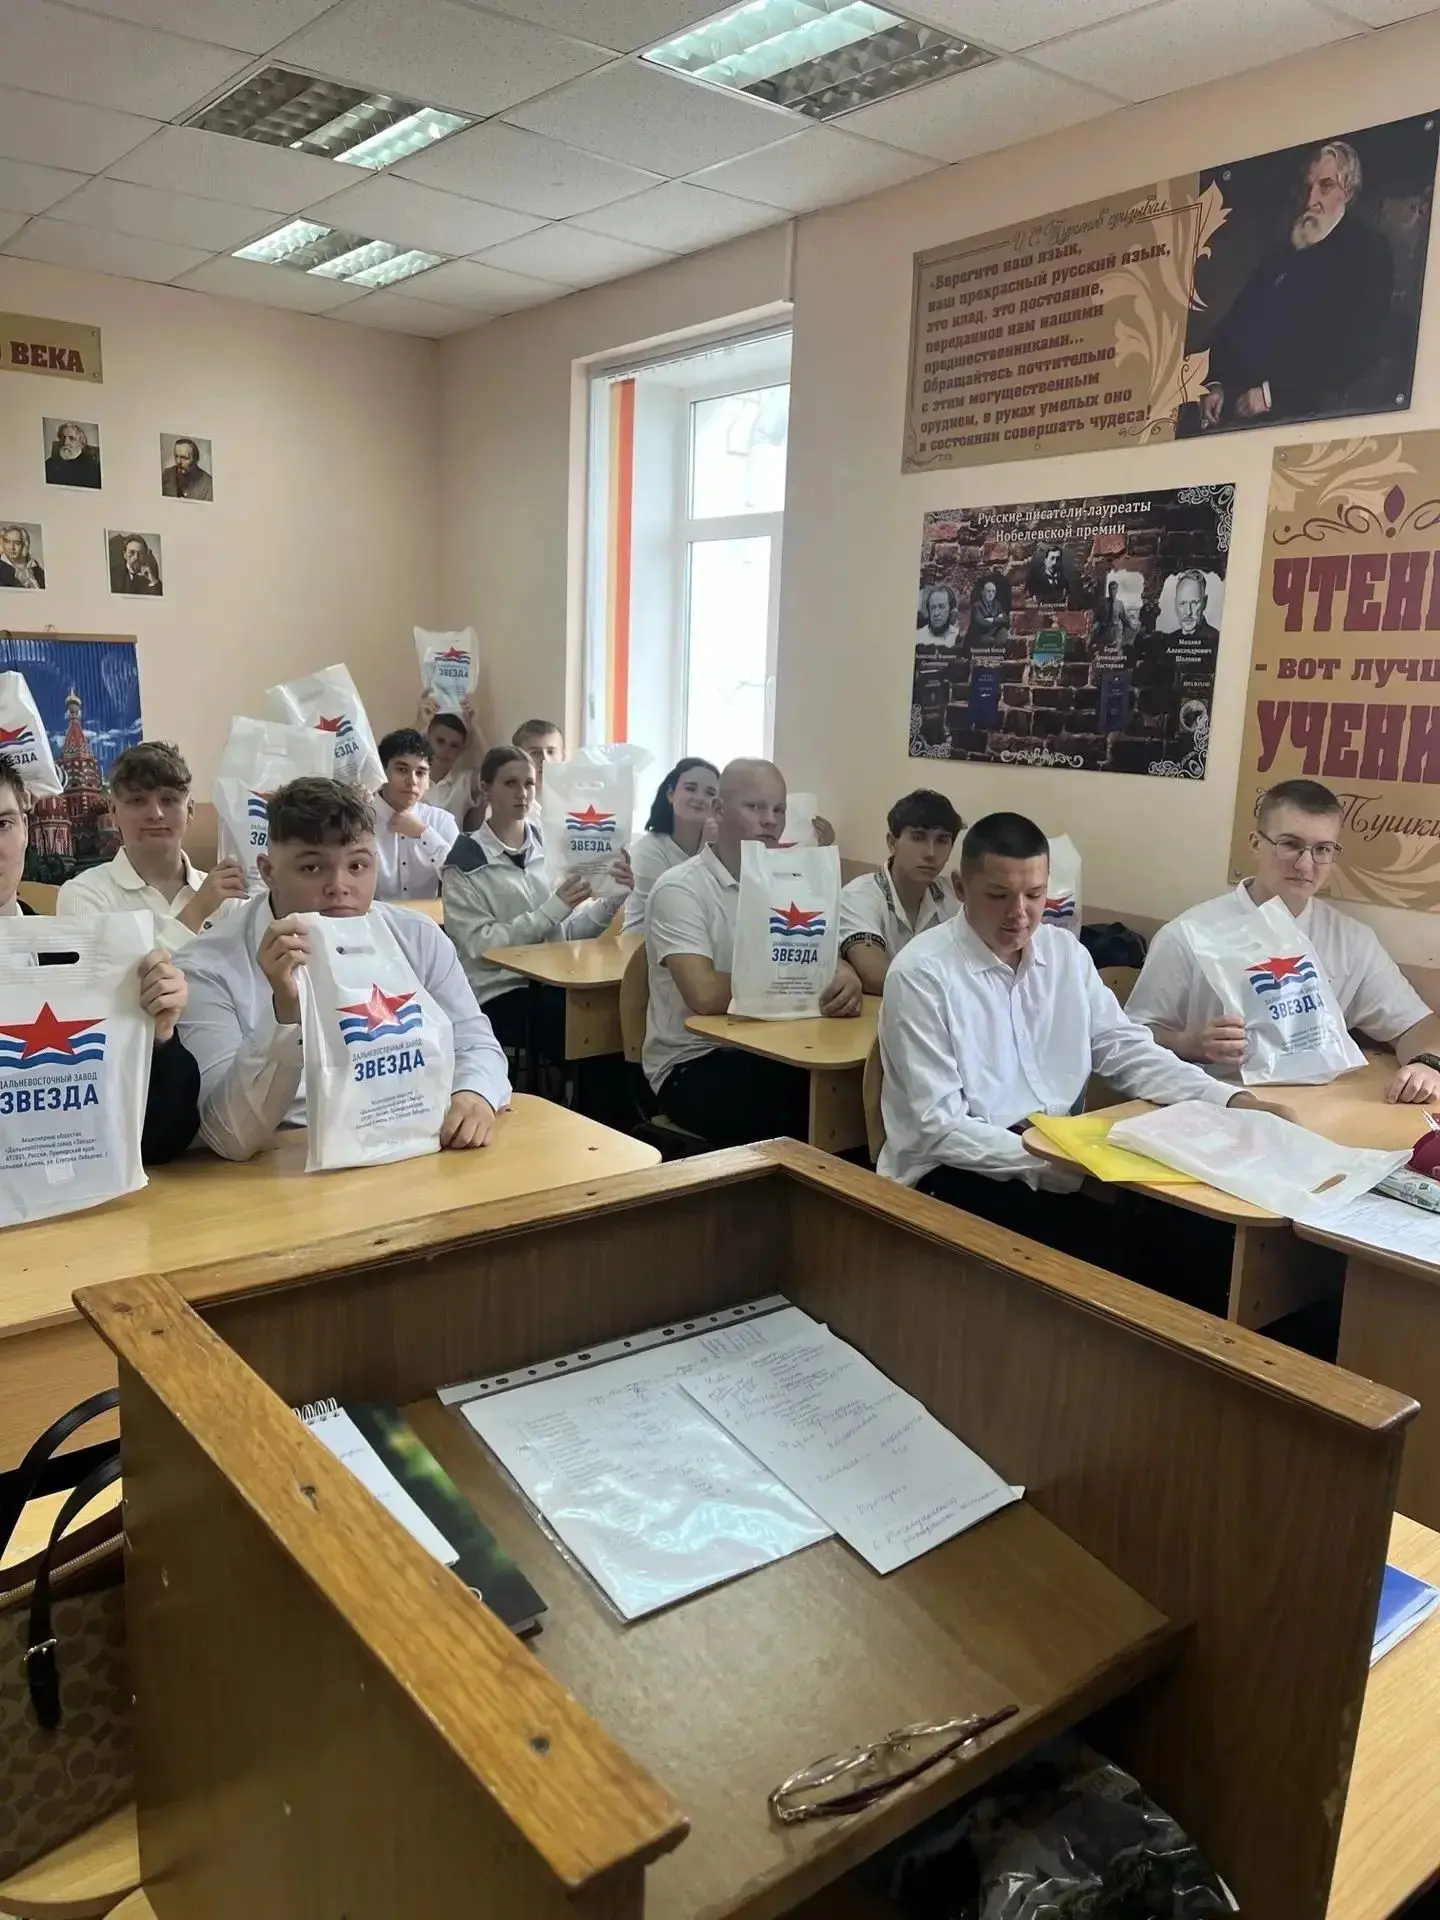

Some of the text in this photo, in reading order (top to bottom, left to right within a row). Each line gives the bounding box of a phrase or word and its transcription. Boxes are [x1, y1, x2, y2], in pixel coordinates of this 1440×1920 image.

[1003, 255, 1033, 273] наш
[1038, 243, 1082, 263] язык,
[928, 243, 1171, 313] наш прекрасный русский язык,
[926, 282, 1104, 334] это клад, это достояние,
[926, 304, 1104, 354] переданное нам нашими
[10, 340, 85, 374] ВЕКА
[923, 347, 1116, 394] Обращайтесь почтительно
[924, 335, 1084, 375] предшественниками...
[921, 372, 1101, 413] с этим могущественным
[920, 388, 1132, 435] орудием, в руках умелых оно
[919, 404, 1152, 453] в состоянии совершать чудеса!
[977, 501, 1152, 528] Русские писатели-лауреаты
[996, 523, 1126, 543] Нобелевской премии
[1277, 658, 1342, 681] вот
[14, 752, 38, 765] ЗДА
[334, 741, 360, 758] ЕЗДА
[249, 831, 268, 846] ЗВ
[570, 840, 613, 852] ЗВЕЗДА
[772, 948, 818, 964] ЗВЕЗДА
[1269, 992, 1325, 1020] ЗВЕЗДА
[73, 1071, 98, 1082] ЗАВОД
[354, 1048, 425, 1082] ЗВЕЗДА
[0, 1083, 99, 1115] ЗВЕЗДА
